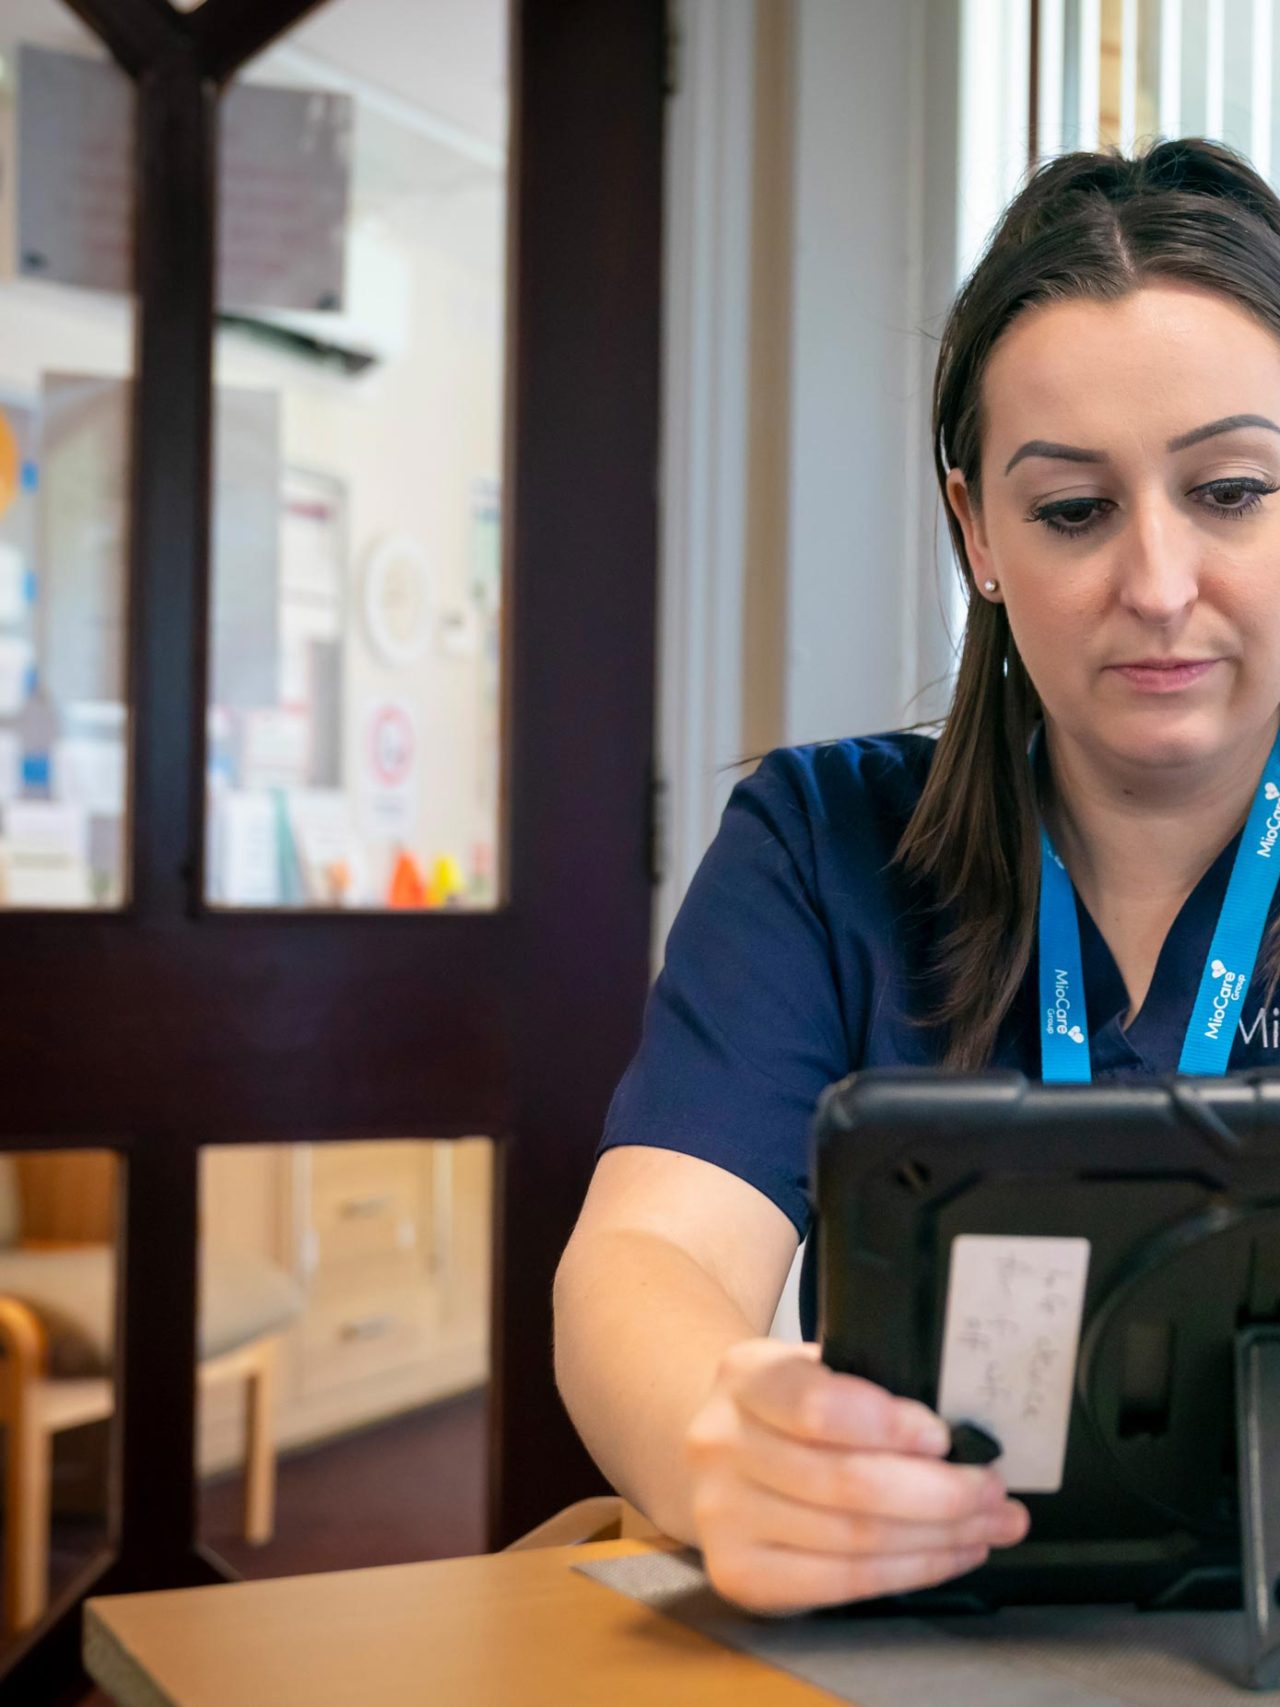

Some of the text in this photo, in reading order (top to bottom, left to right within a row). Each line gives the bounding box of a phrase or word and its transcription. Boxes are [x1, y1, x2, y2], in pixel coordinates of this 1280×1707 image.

[1054, 969, 1071, 1035] MioCare
[1204, 971, 1236, 1040] MioCare
[1231, 974, 1245, 1001] Group
